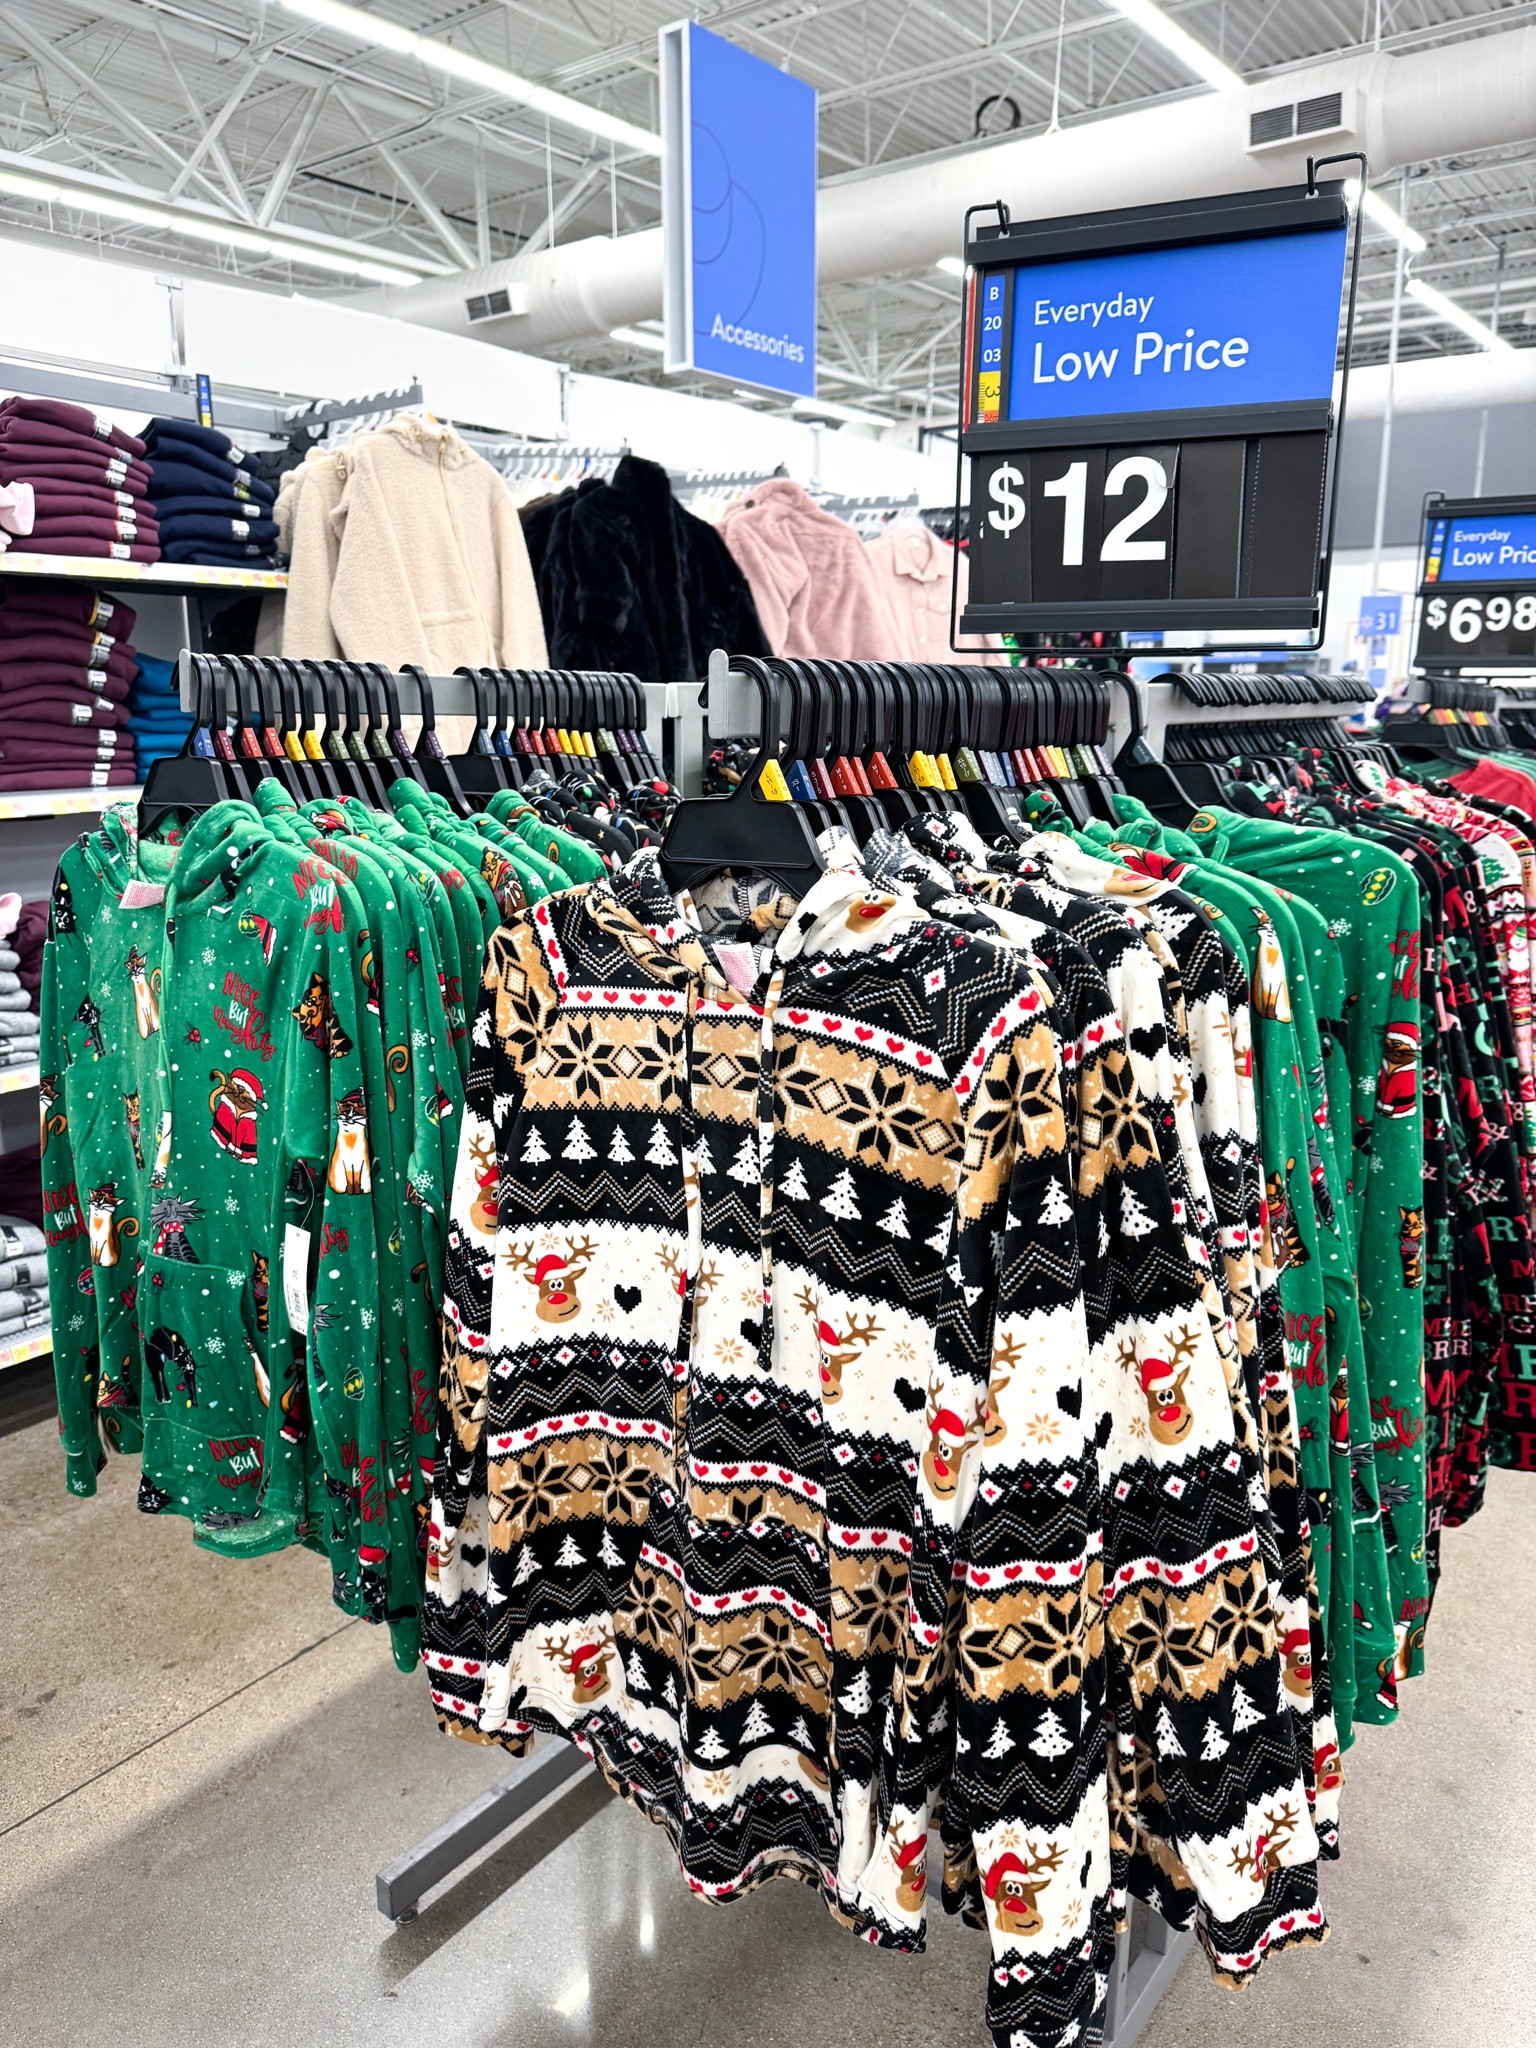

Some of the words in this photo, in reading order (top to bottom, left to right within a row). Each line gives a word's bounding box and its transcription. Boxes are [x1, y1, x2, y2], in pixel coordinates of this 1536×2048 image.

[990, 286, 999, 301] B
[1035, 291, 1155, 327] Everyday
[983, 315, 1002, 331] 20
[711, 313, 805, 364] Accessories
[983, 348, 1002, 364] 03
[1033, 342, 1120, 384] Low
[1134, 328, 1250, 376] Price
[987, 455, 1169, 567] $12
[1453, 529, 1512, 545] Everyday
[1452, 547, 1495, 567] Low
[1375, 611, 1397, 631] 31
[213, 1004, 278, 1063] naughty
